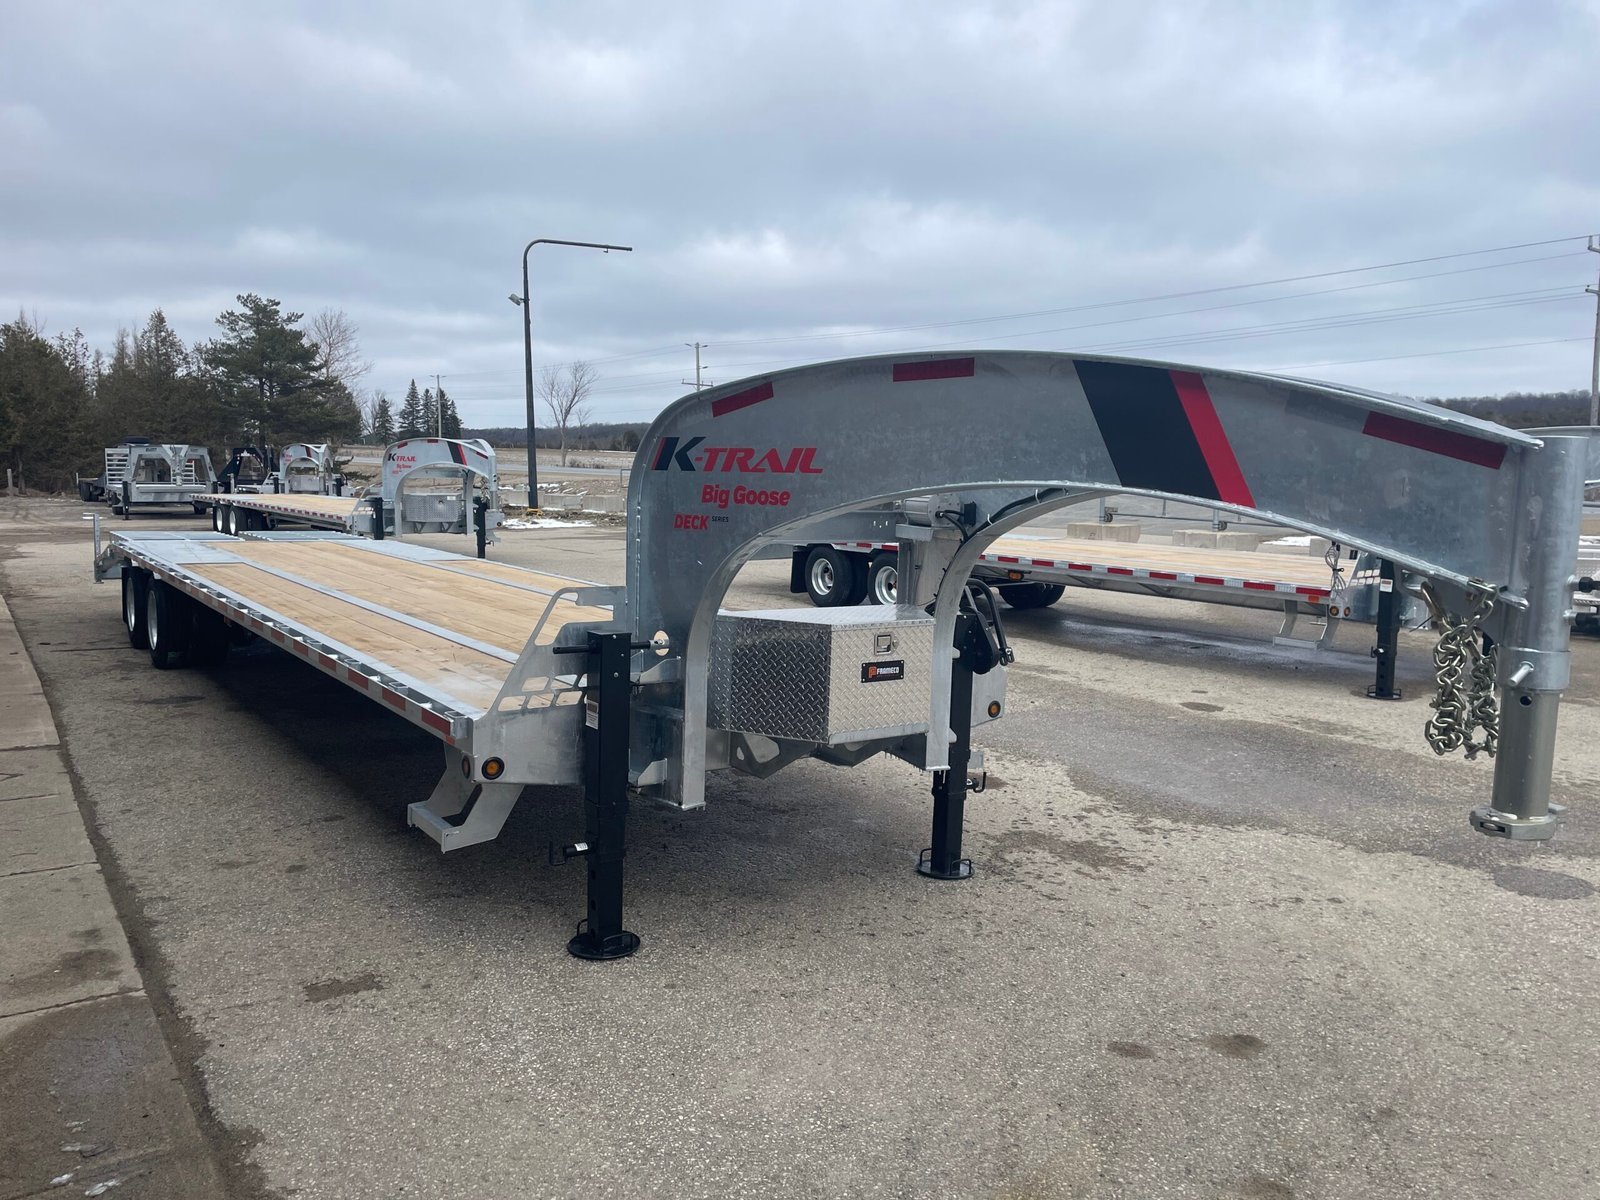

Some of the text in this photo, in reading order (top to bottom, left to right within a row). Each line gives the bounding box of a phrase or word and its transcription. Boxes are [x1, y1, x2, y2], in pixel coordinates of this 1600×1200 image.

[651, 436, 824, 474] K-TRAIL
[701, 484, 791, 509] Big Goose
[673, 513, 729, 530] DECK SERIES
